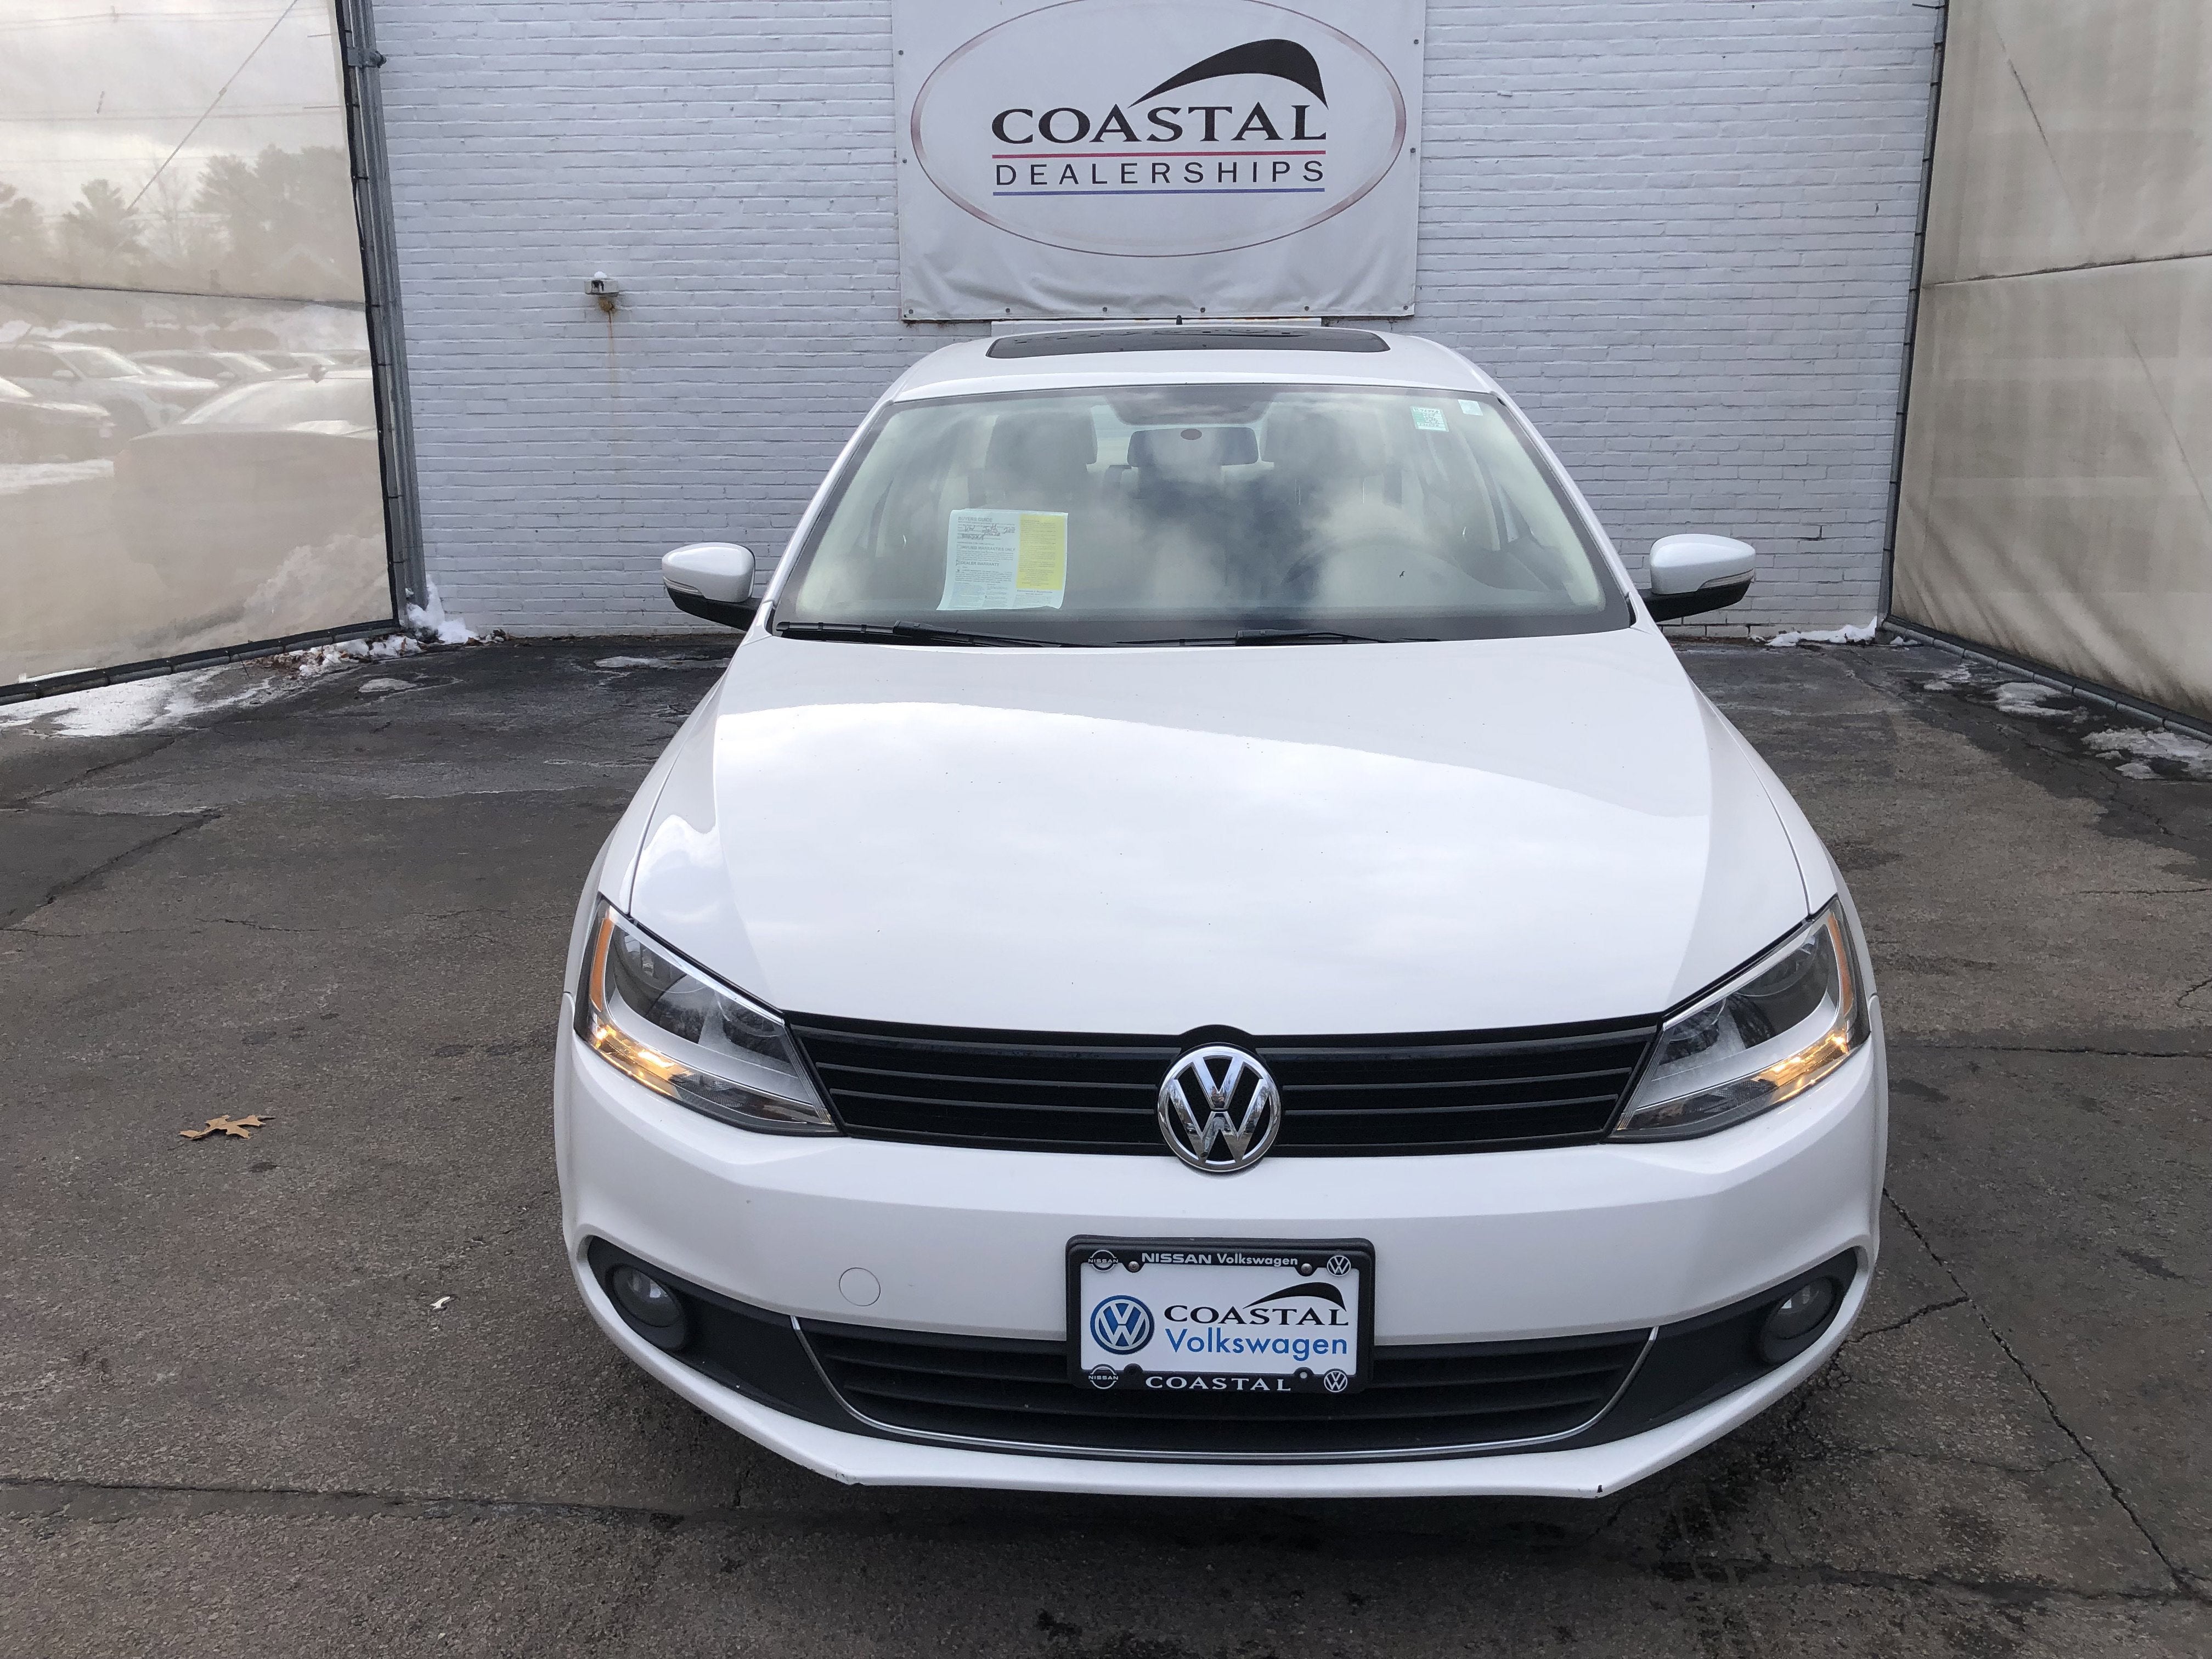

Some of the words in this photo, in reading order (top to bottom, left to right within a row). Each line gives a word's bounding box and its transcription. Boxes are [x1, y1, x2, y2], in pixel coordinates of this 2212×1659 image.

[992, 101, 1328, 144] COASTAL
[995, 160, 1324, 186] DEALERSHIPS
[1142, 1252, 1212, 1264] NISSAN
[1216, 1252, 1298, 1267] Volkswagen
[1164, 1305, 1349, 1326] COASTAL
[1165, 1327, 1347, 1362] Volkswagen
[1146, 1375, 1291, 1391] COASTAL
